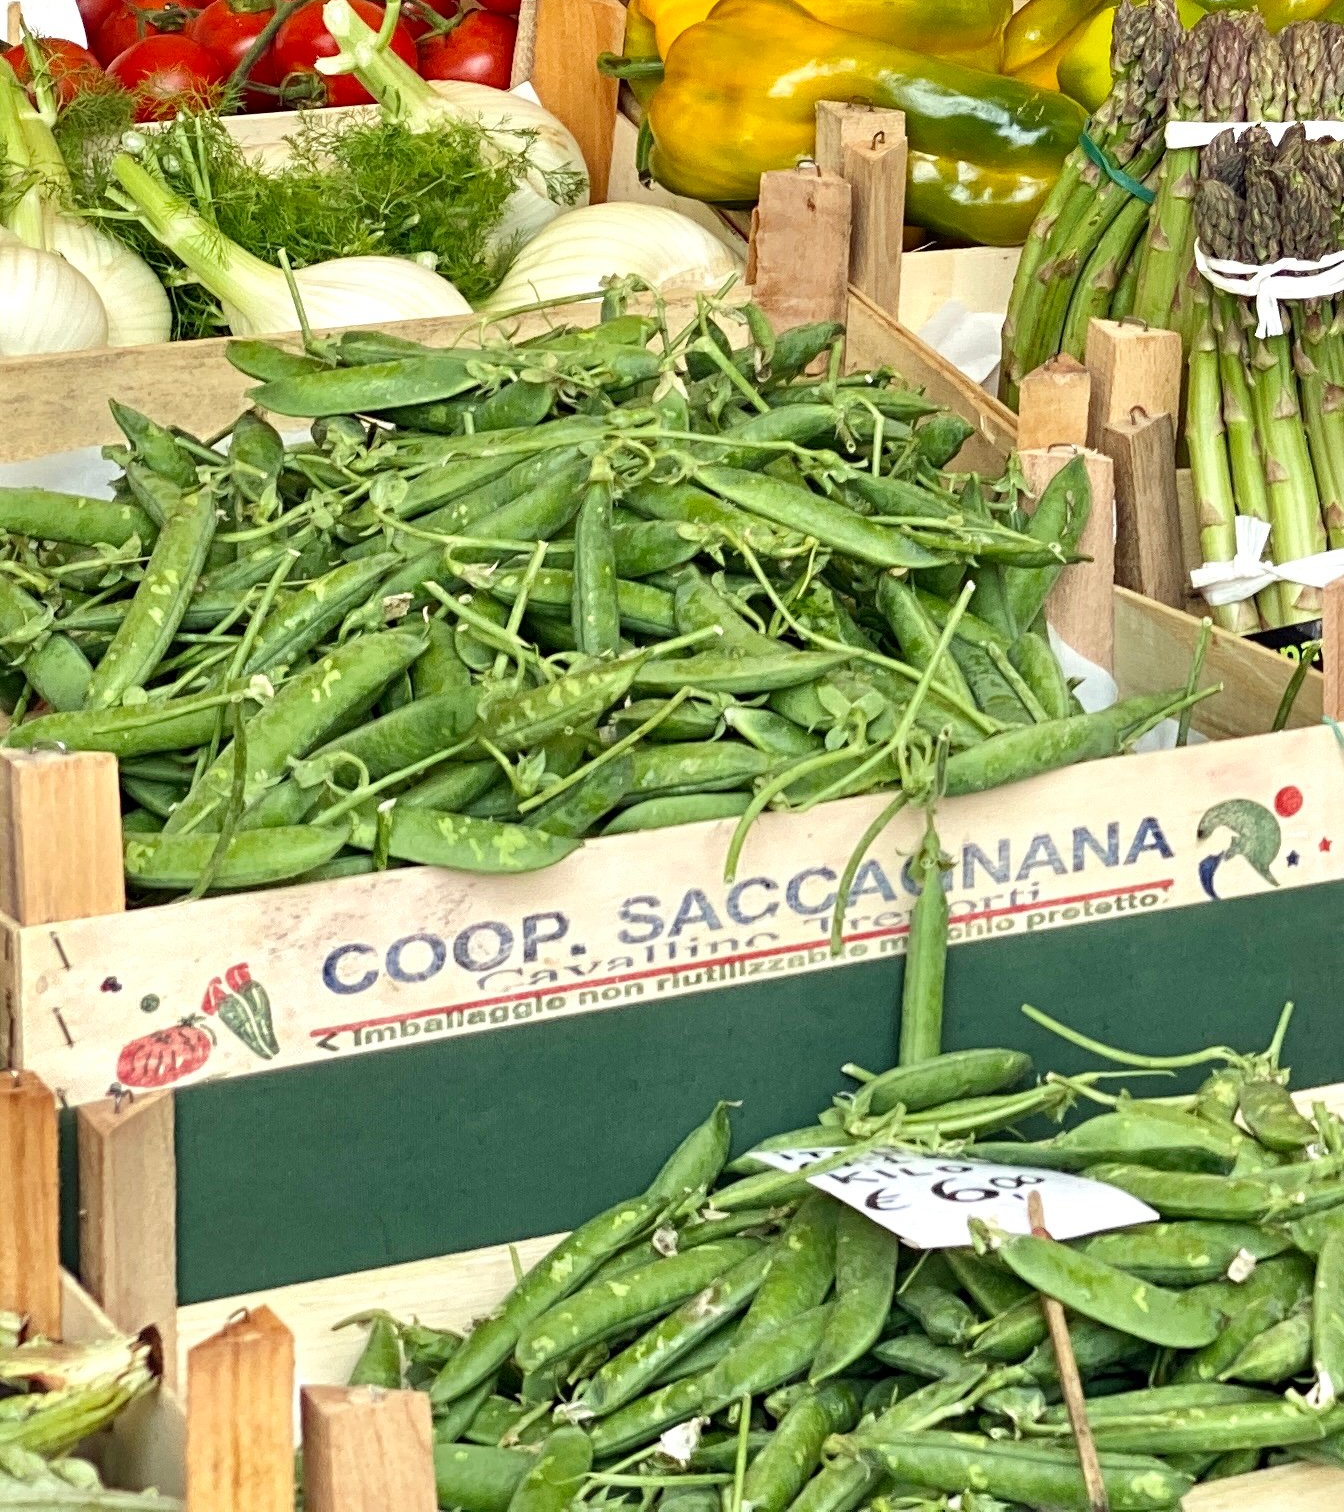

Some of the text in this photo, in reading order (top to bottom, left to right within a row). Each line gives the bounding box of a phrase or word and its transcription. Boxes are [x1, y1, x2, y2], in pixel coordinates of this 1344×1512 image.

[322, 912, 589, 996] COOP.
[577, 976, 646, 1008] non
[879, 911, 1017, 955] mchio
[1026, 890, 1158, 933] protetto
[818, 881, 1041, 951] Treorti
[826, 1165, 976, 1187] KILO
